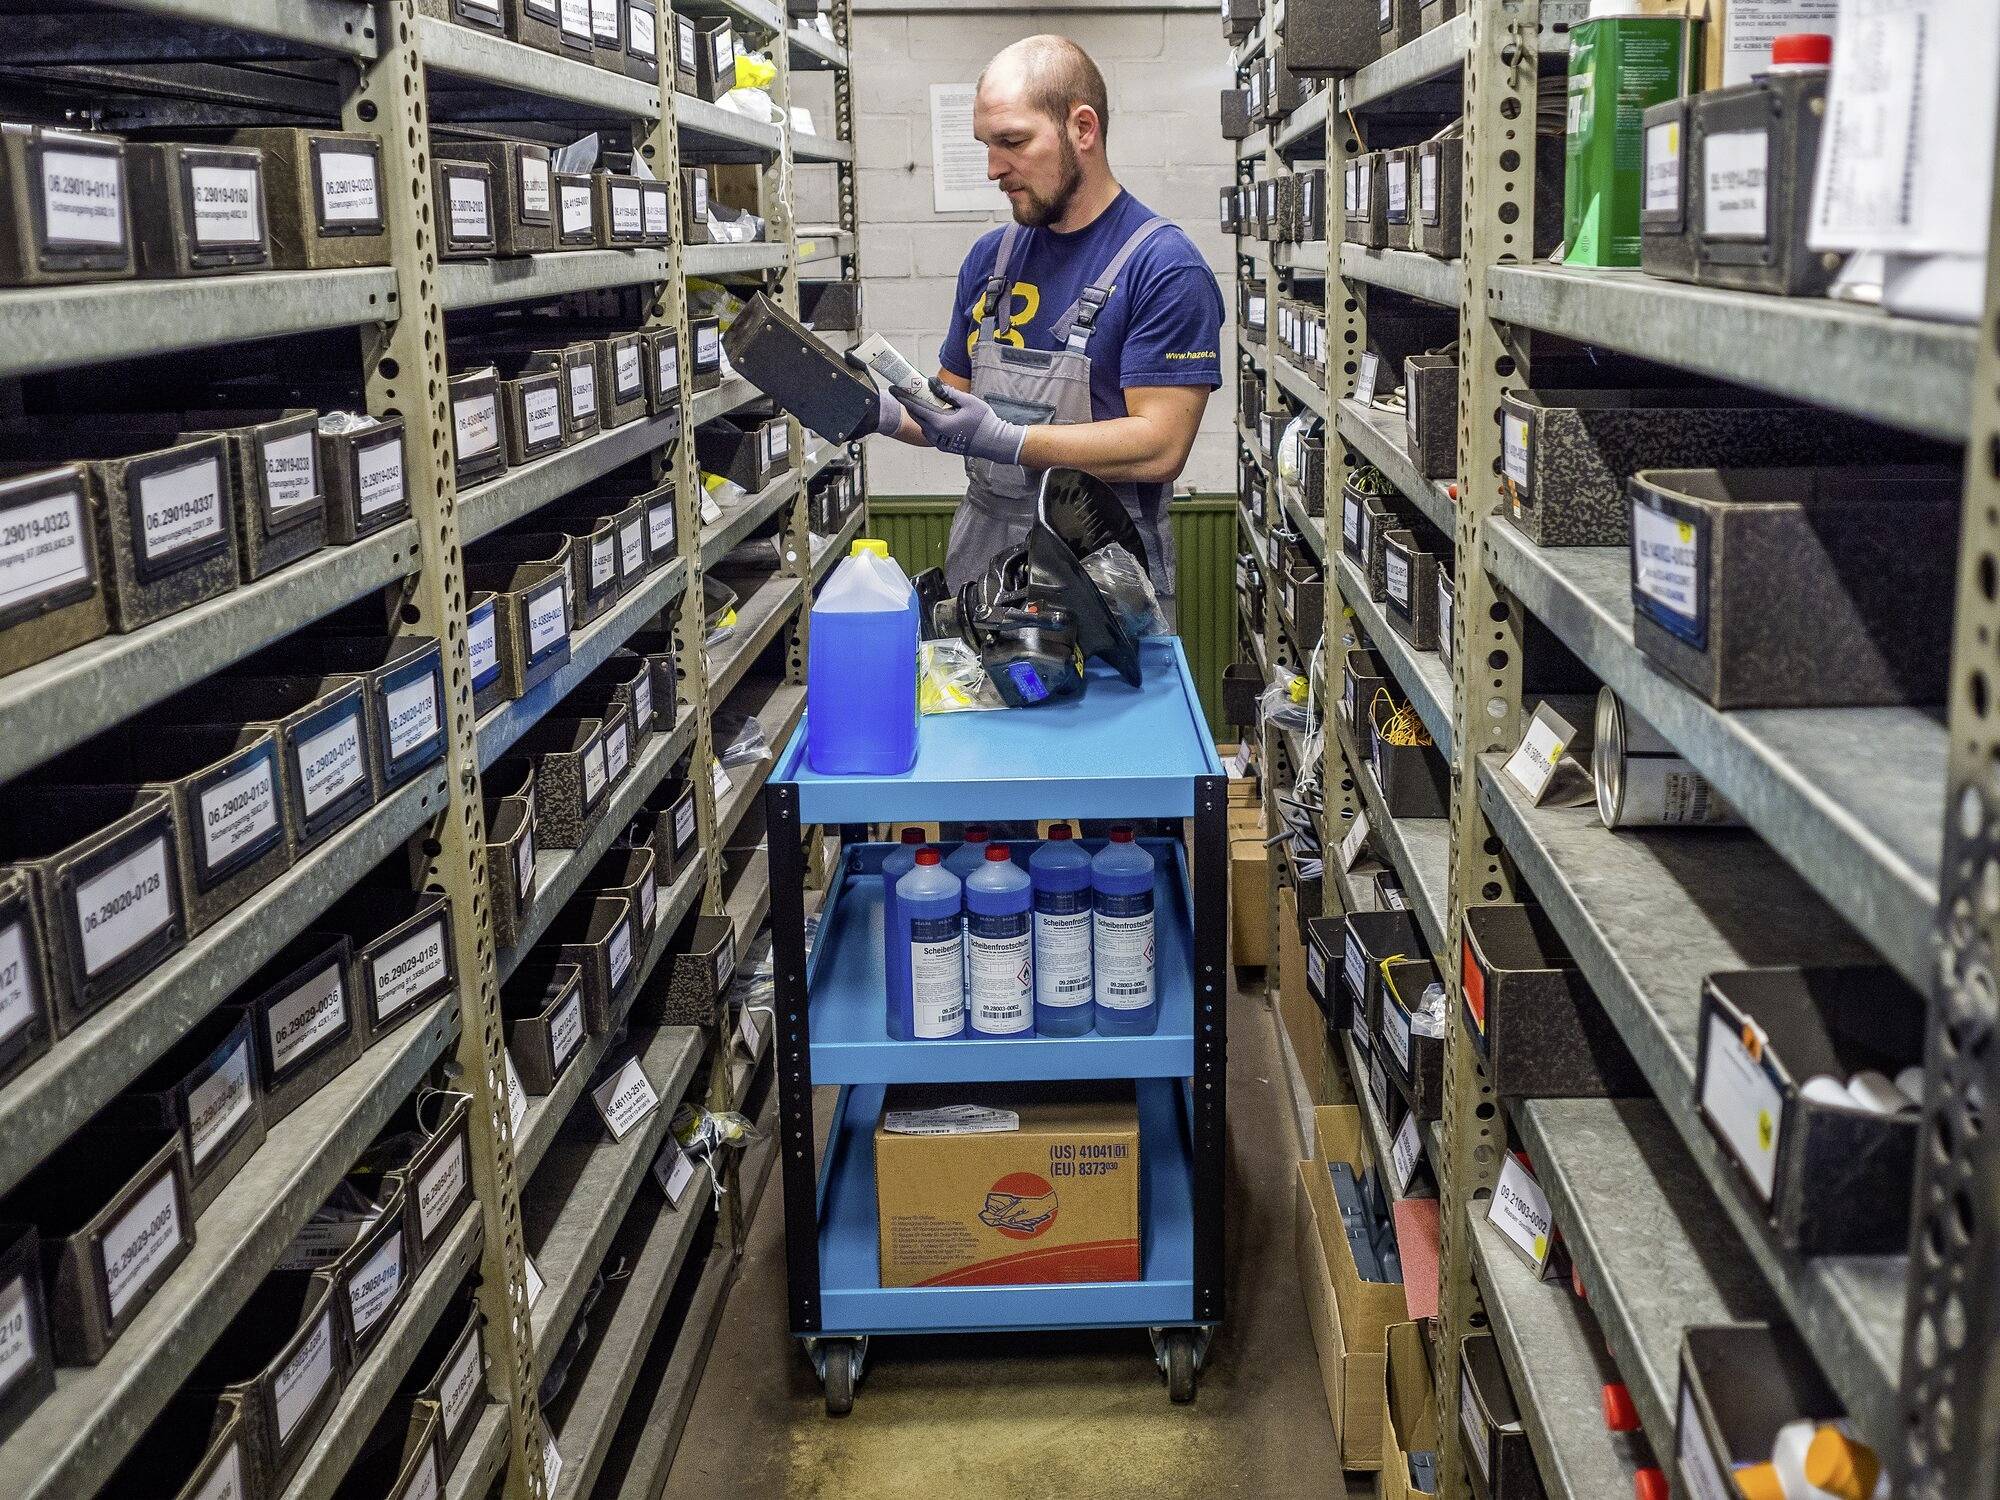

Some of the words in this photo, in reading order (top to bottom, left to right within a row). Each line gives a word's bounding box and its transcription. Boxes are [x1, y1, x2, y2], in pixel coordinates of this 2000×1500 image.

[48, 175, 116, 198] 06.29019-0114
[326, 178, 374, 195] 06.29019-0320
[1165, 350, 1217, 361] www.hazet.de
[146, 493, 215, 531] 06.29019-0337
[305, 735, 357, 782] 06.29020-0134
[208, 777, 270, 827] 06.29020-0130
[211, 813, 251, 843] Sicherungsring
[85, 872, 161, 934] 06.29020-0128
[378, 942, 438, 988] 06.29029-0189
[377, 981, 406, 1003] Sprengring
[405, 983, 418, 995] PHR
[276, 989, 339, 1043] 06.29029-0036
[277, 1026, 318, 1058] Sicherungsring
[607, 1079, 646, 1117] 06.46113-2510
[1050, 1144, 1076, 1161] (US)
[1050, 1162, 1076, 1178] (EU)
[1500, 1184, 1547, 1235] 09.21003-0002
[107, 1204, 172, 1285] 06.29029-0005
